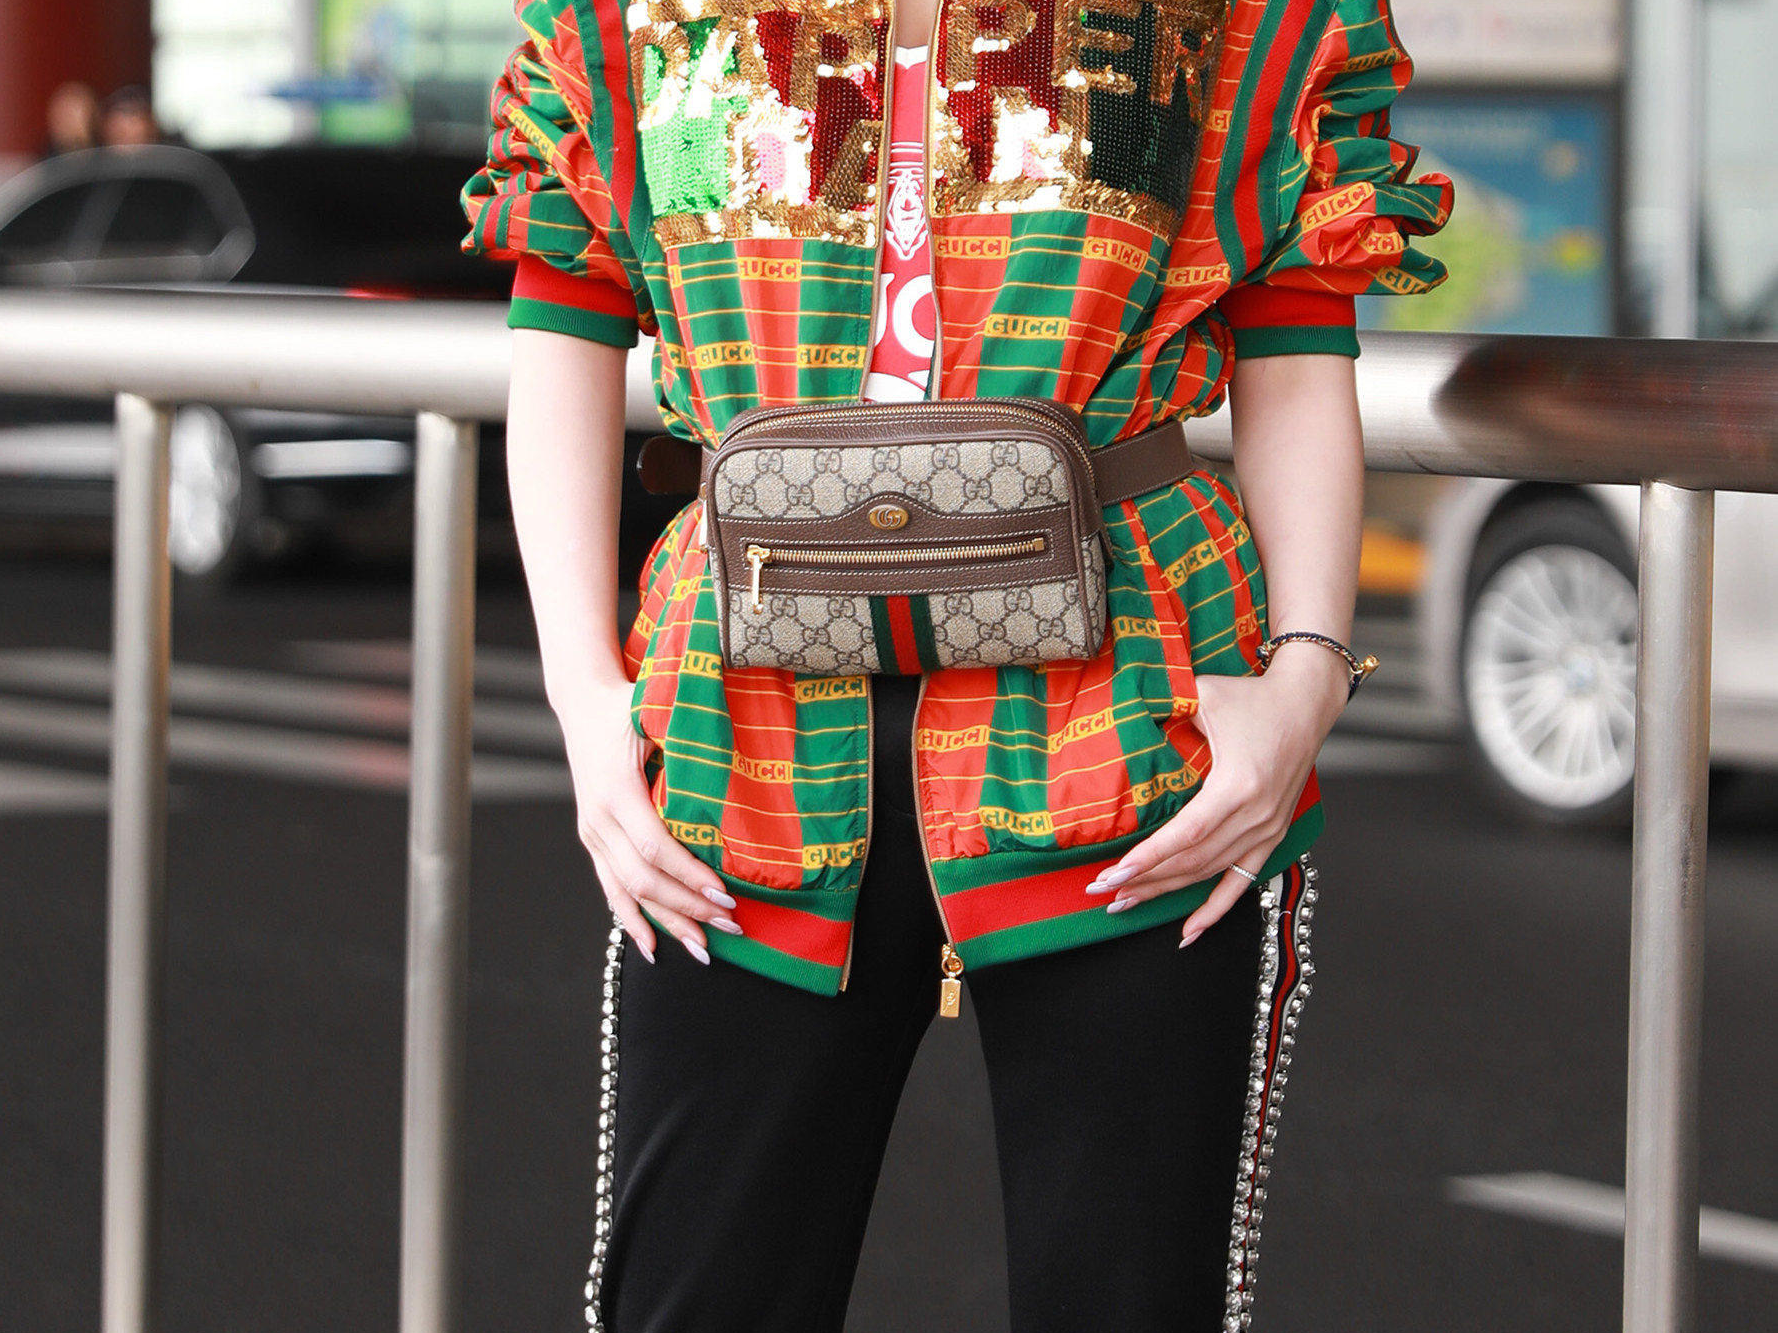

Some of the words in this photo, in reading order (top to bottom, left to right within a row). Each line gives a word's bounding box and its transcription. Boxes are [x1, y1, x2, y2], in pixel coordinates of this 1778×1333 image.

[1302, 183, 1373, 229] GUCCI
[935, 238, 1008, 258] GUCCI
[1087, 239, 1146, 271] GUCCI
[1172, 267, 1230, 286] GUCC
[988, 318, 1069, 338] GUCCI
[799, 347, 866, 366] GUCCI
[799, 679, 866, 699] GUCCI
[919, 726, 989, 751] GUCCI
[735, 761, 792, 781] GUCCI
[982, 808, 1052, 835] GUCCI
